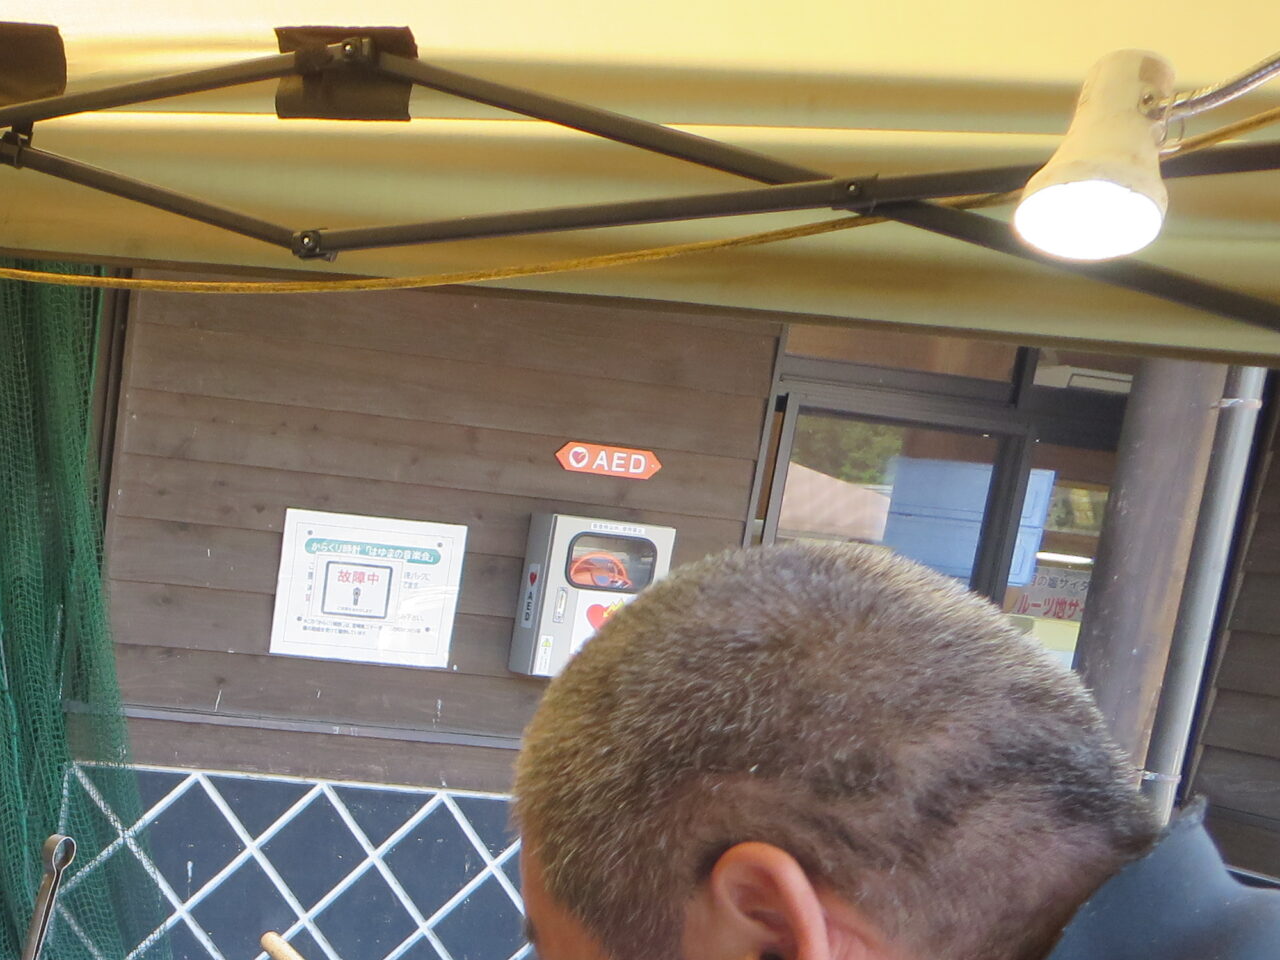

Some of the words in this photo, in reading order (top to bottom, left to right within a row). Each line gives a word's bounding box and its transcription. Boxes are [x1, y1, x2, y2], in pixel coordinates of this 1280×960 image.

[592, 450, 646, 473] AED
[337, 569, 380, 585] 故障中
[524, 591, 534, 622] AED
